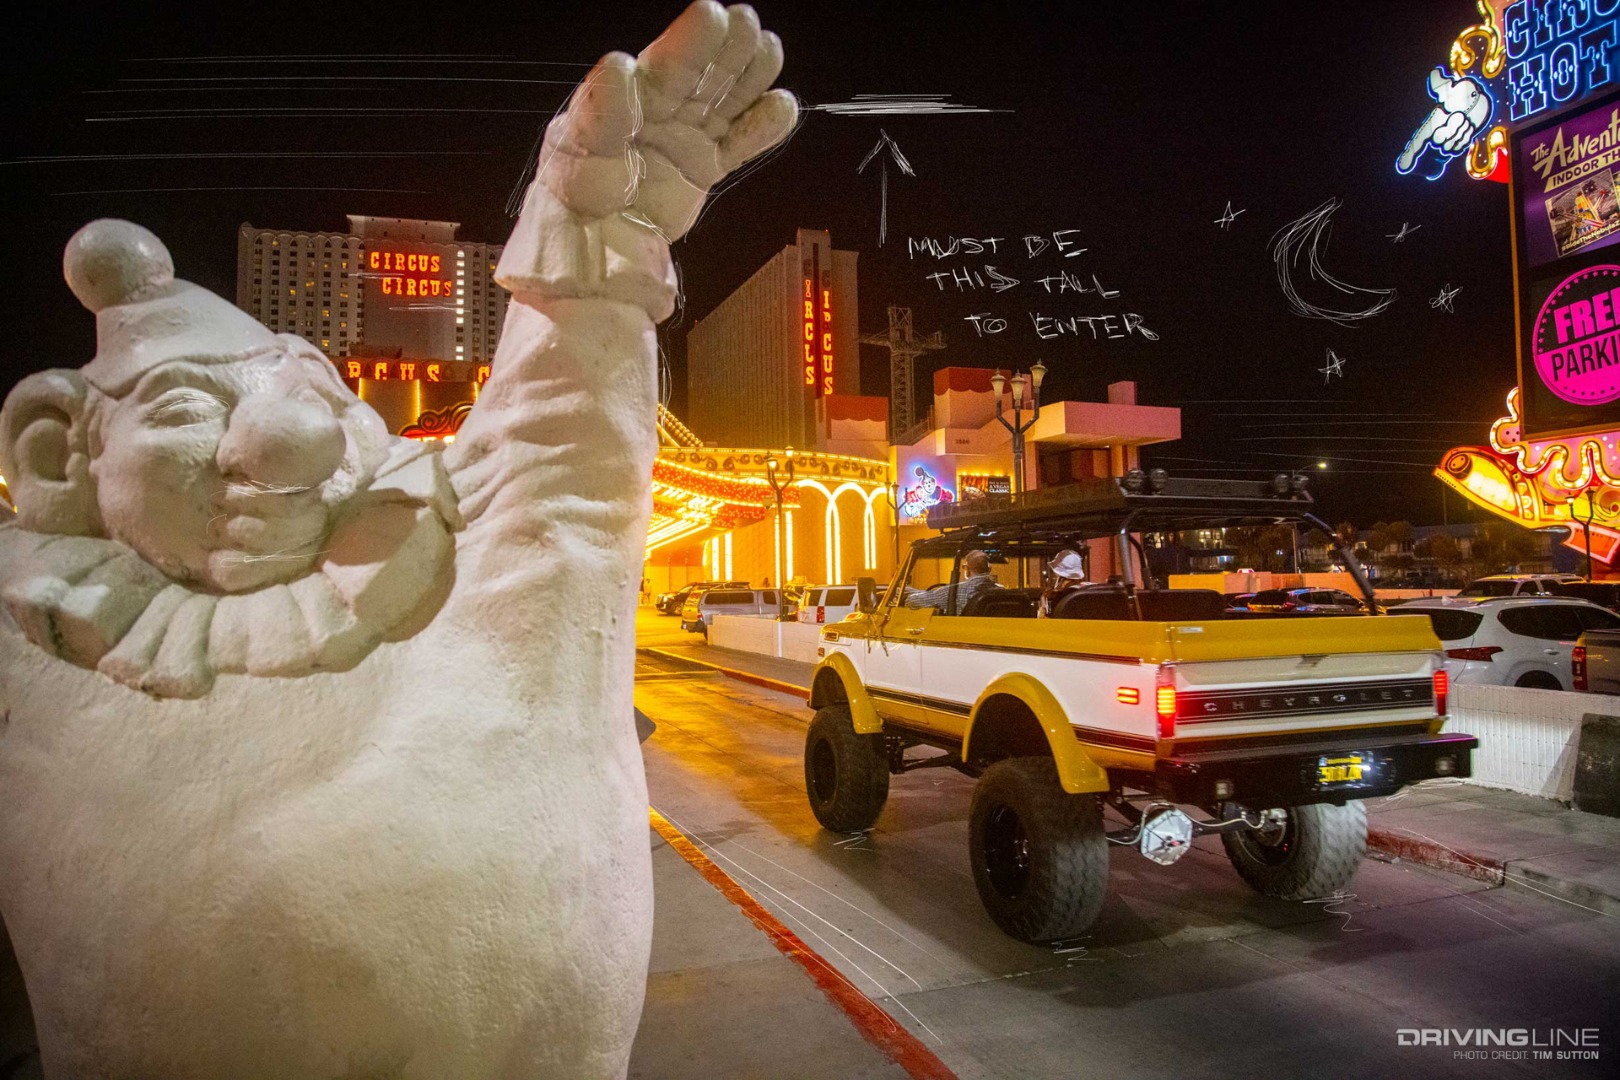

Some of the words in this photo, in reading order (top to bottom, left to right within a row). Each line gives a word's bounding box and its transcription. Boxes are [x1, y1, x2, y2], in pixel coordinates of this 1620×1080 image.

[1504, 0, 1620, 60] CIR
[1509, 19, 1618, 122] HOT
[1530, 142, 1550, 163] The
[1532, 108, 1620, 180] Advent
[1552, 158, 1600, 188] INDOOR
[370, 251, 440, 273] CIRCUS
[382, 277, 452, 297] CIRCUS
[1551, 333, 1620, 382] PARKI
[1204, 689, 1414, 713] CHEVROLET
